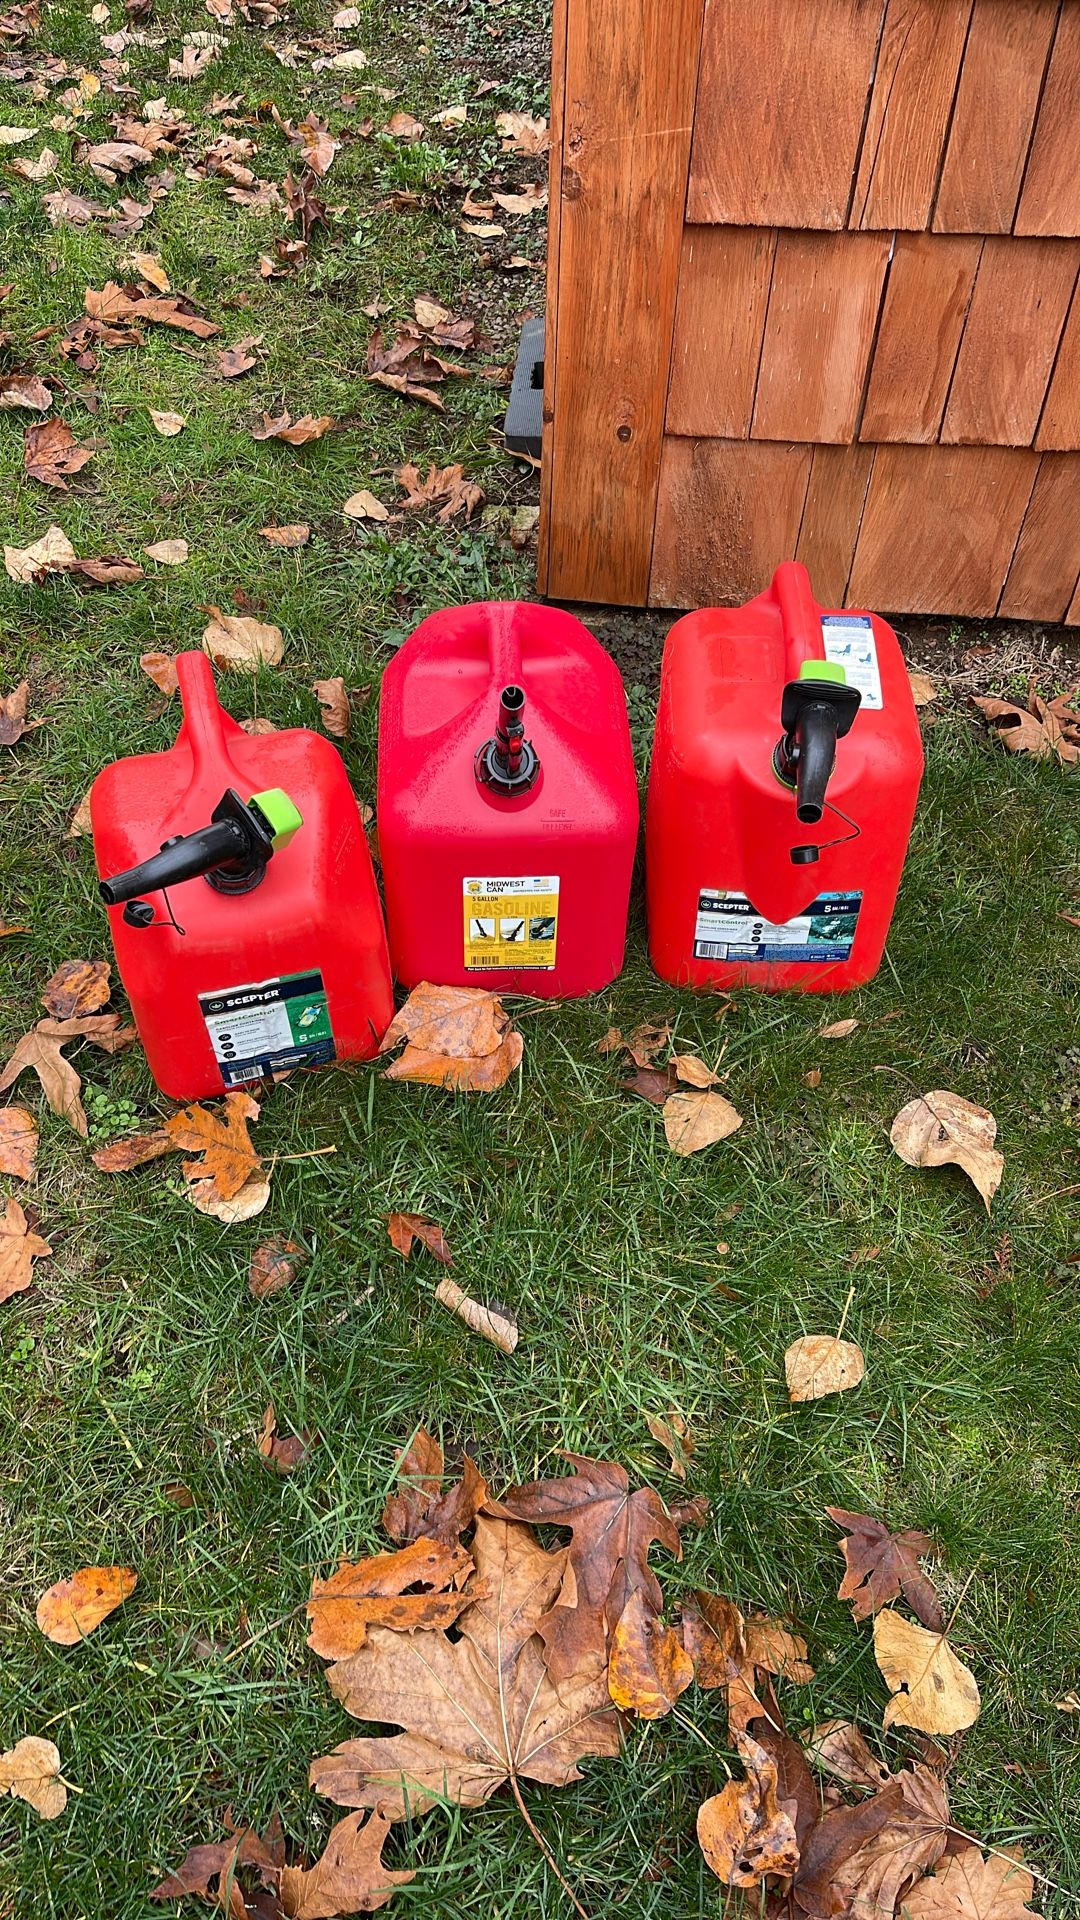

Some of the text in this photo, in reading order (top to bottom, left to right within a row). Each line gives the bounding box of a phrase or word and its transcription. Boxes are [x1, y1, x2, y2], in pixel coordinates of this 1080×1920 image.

[471, 902, 551, 916] GASOLINE
[712, 902, 749, 911] SCEPTER
[824, 905, 832, 913] 5
[226, 990, 280, 1007] SCEPTER
[299, 1033, 308, 1043] 5
